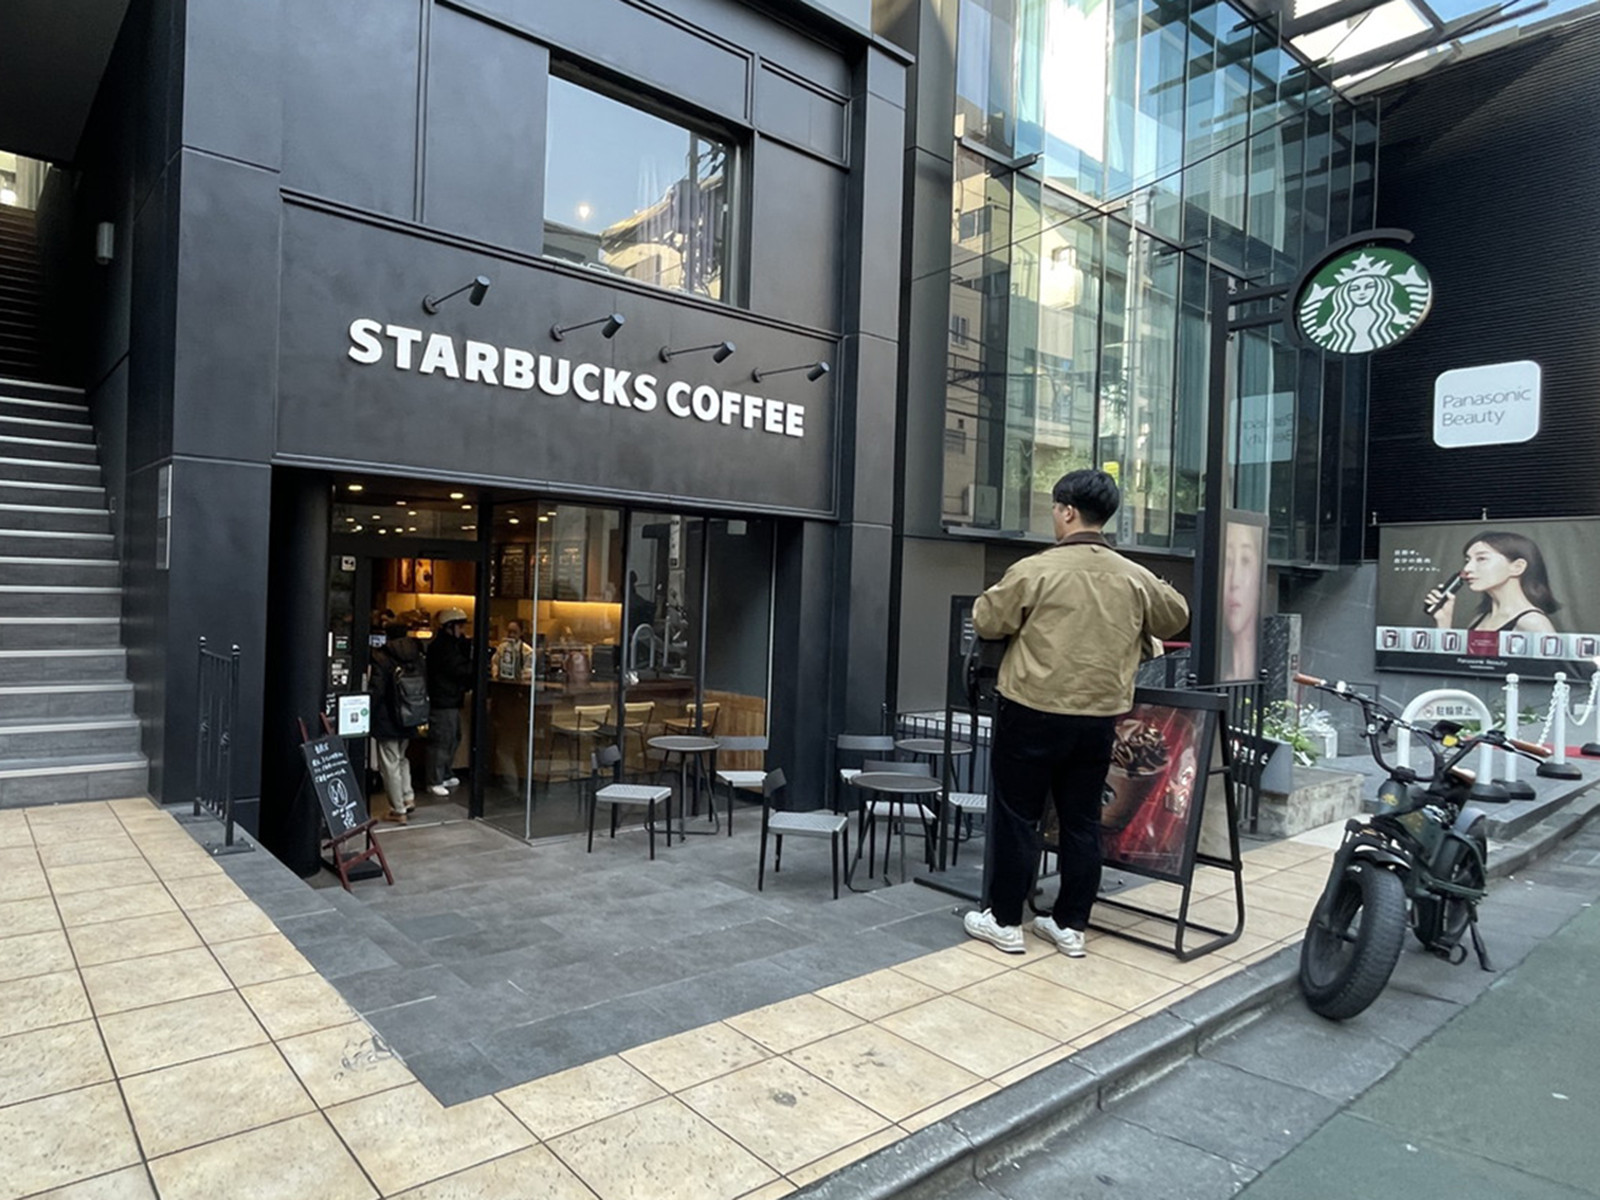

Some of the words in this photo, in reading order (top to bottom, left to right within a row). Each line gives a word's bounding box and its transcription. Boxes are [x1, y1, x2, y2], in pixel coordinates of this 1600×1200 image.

[347, 317, 658, 412] STARBUCKS
[666, 384, 806, 438] COFFEE
[1442, 385, 1532, 409] Panasonic
[1442, 409, 1506, 427] Beauty
